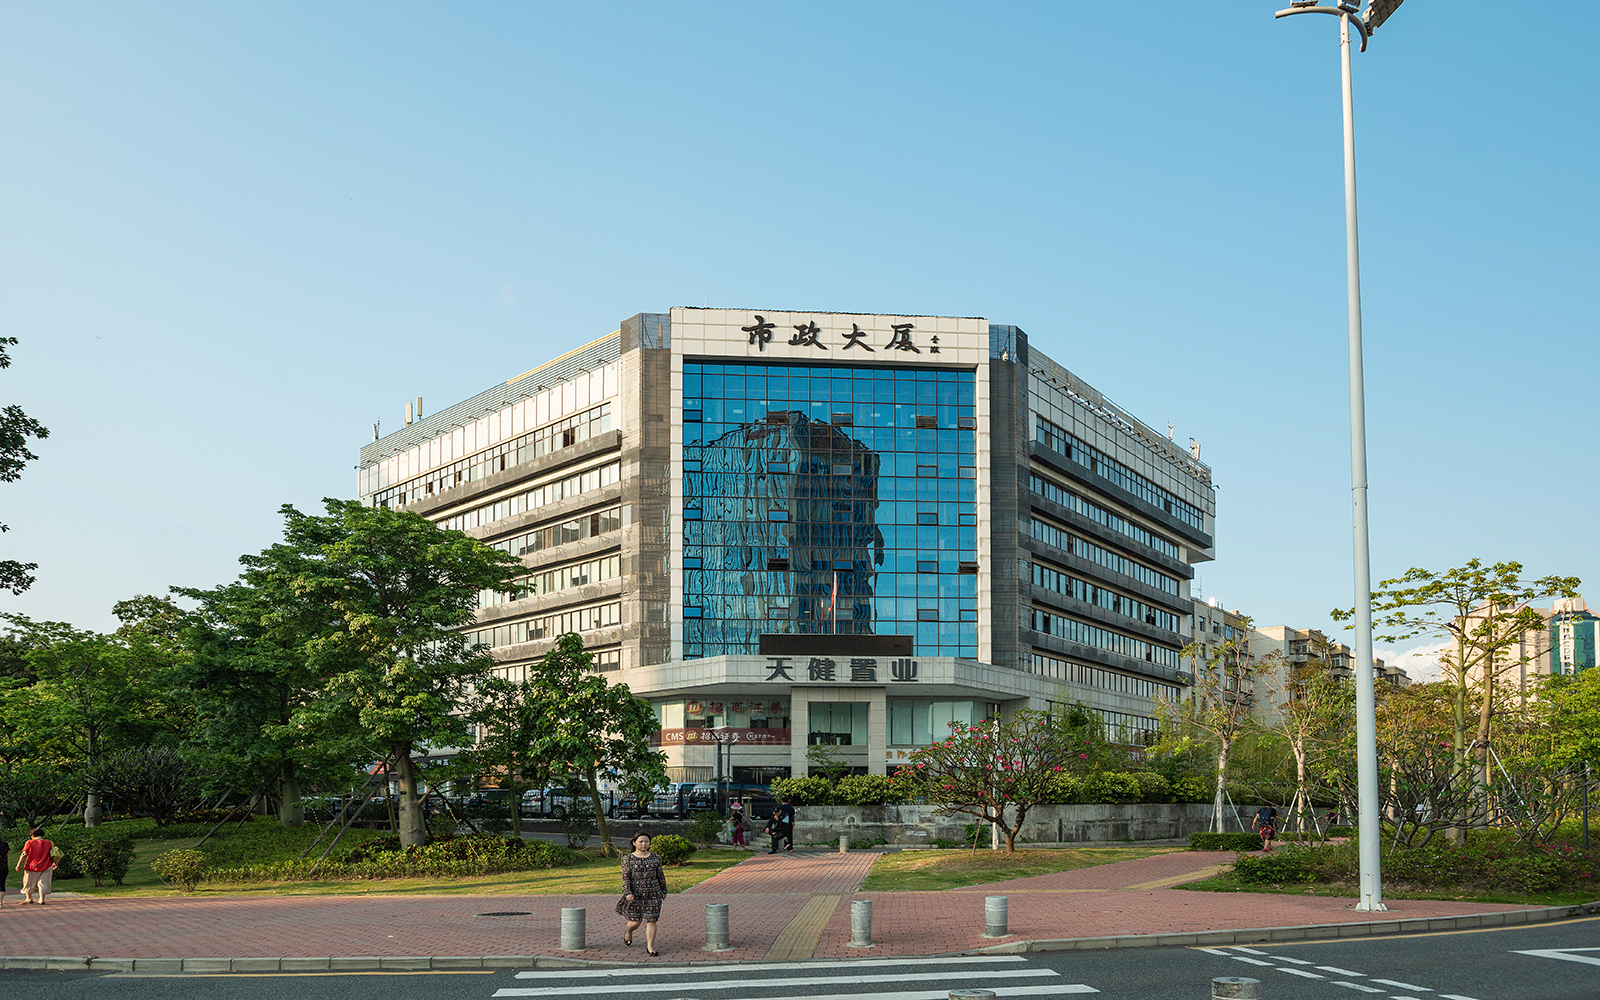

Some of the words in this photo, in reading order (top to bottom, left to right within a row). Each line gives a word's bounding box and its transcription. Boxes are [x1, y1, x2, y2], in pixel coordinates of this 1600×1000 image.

[741, 315, 921, 354] 市政大厦
[765, 657, 919, 682] 天健置业
[708, 701, 783, 714] 招商证券
[665, 732, 685, 741] CMS
